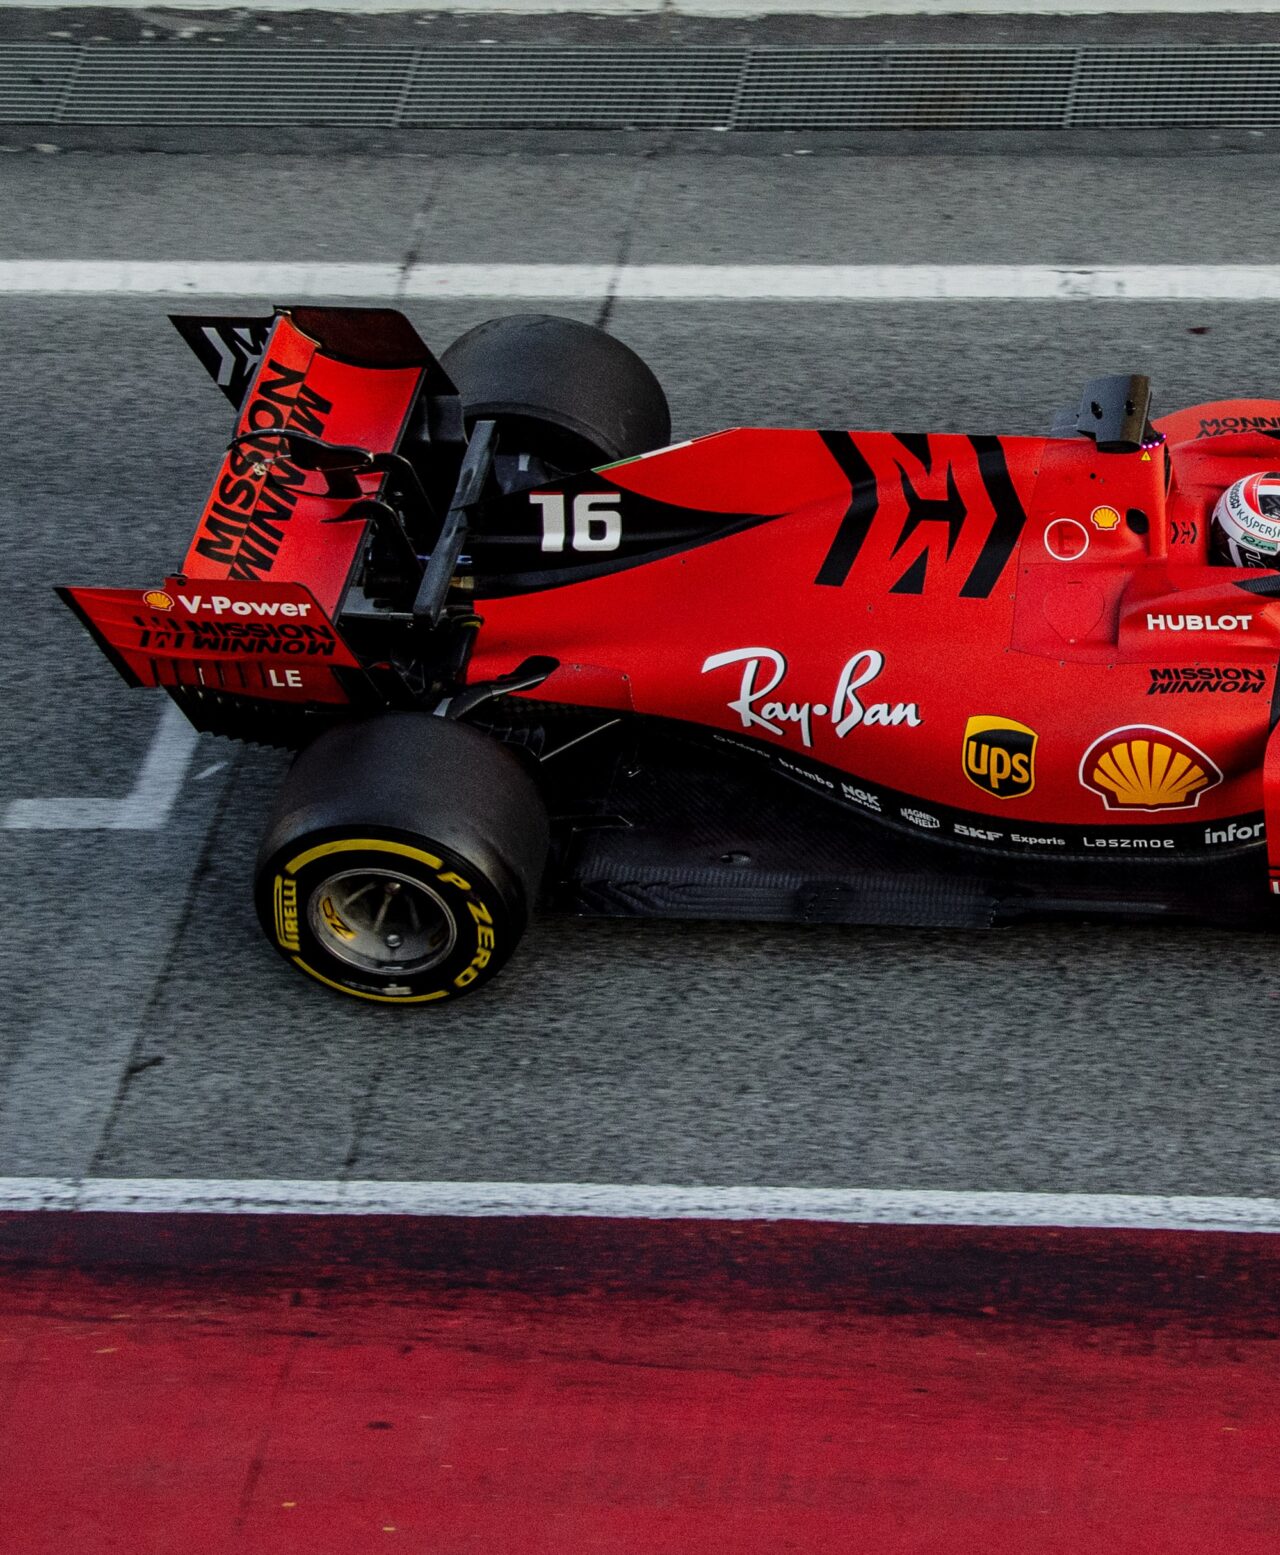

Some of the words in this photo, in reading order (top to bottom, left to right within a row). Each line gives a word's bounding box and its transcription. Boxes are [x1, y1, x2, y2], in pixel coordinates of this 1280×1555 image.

[196, 359, 306, 565] MISSION
[529, 491, 622, 551] 16
[177, 595, 311, 617] V-Power
[185, 620, 335, 640] MISSION
[1146, 613, 1253, 631] HUBLOT
[192, 634, 336, 656] WINNOW
[1149, 667, 1267, 681] MISSION
[1146, 680, 1265, 695] WINNOW
[778, 757, 835, 789] brembo
[967, 740, 1030, 789] ups
[841, 782, 881, 806] NGK
[953, 823, 1004, 842] SKF
[1010, 833, 1066, 846] Experis
[1083, 836, 1176, 849] Laszmoe
[1204, 822, 1265, 845] infor
[437, 871, 472, 892] P
[273, 874, 301, 951] PIRELLI
[454, 901, 495, 988] ZERO
